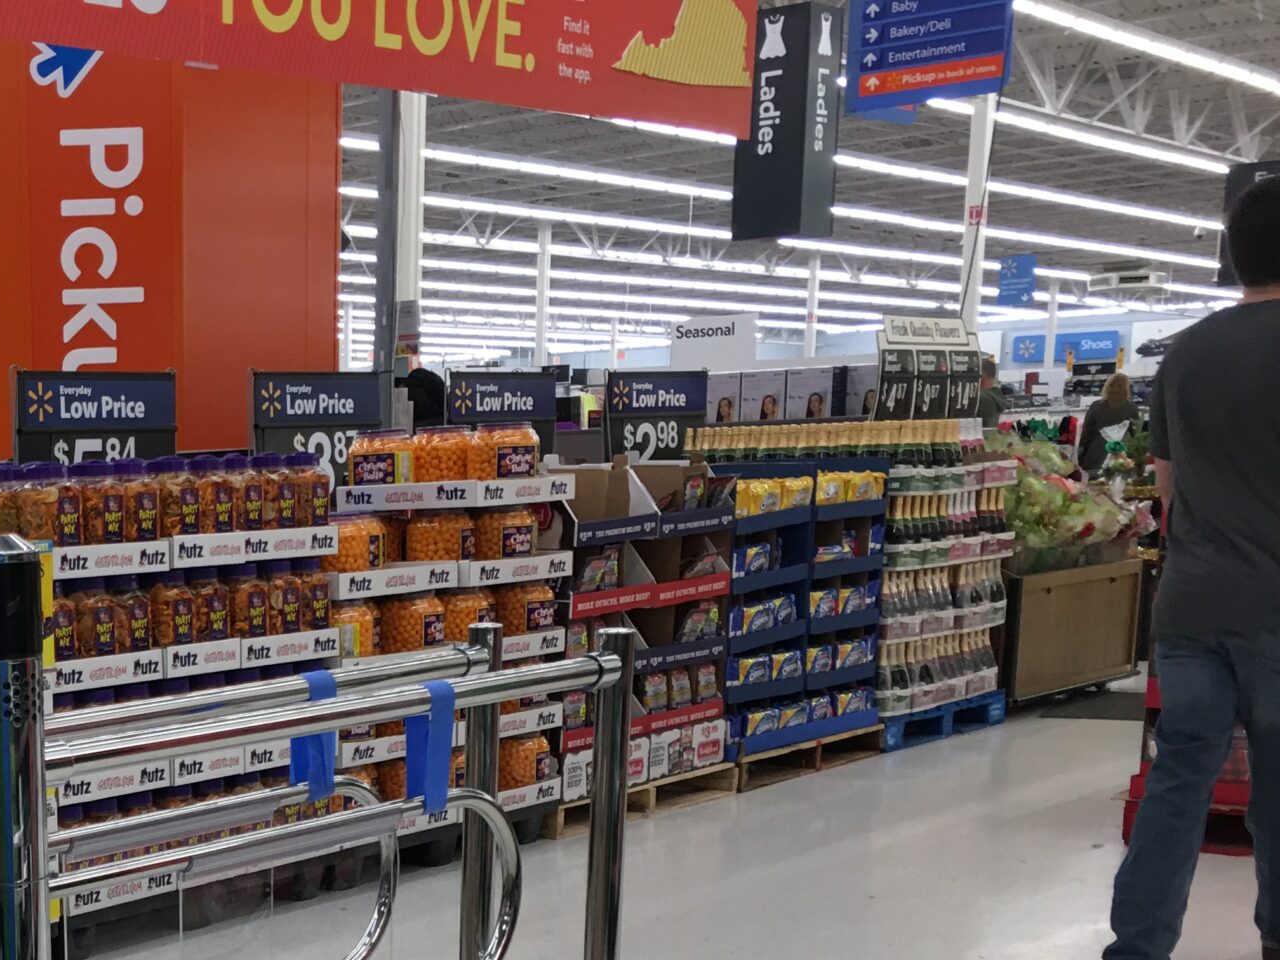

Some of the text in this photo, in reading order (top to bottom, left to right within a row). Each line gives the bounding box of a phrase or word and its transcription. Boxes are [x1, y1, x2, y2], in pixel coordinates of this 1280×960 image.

[891, 0, 919, 14] Baby
[563, 16, 591, 36] Find it
[889, 18, 953, 40] Bakery/Deli
[556, 38, 594, 59] fast with
[887, 41, 967, 64] Entertainment
[558, 63, 592, 83] the app.
[901, 70, 937, 85] Pickup
[756, 69, 783, 157] Ladies
[814, 67, 830, 152] Ladies
[675, 322, 736, 340] Seasonal
[1081, 338, 1113, 351] Shoes
[59, 385, 92, 398] Everyday
[286, 384, 313, 394] Everyday
[476, 384, 499, 394] Everyday
[632, 382, 654, 392] Everyday
[60, 395, 145, 419] Low Price
[286, 392, 355, 415] Low Price
[476, 392, 534, 413] Low Price
[632, 389, 687, 409] Low Price
